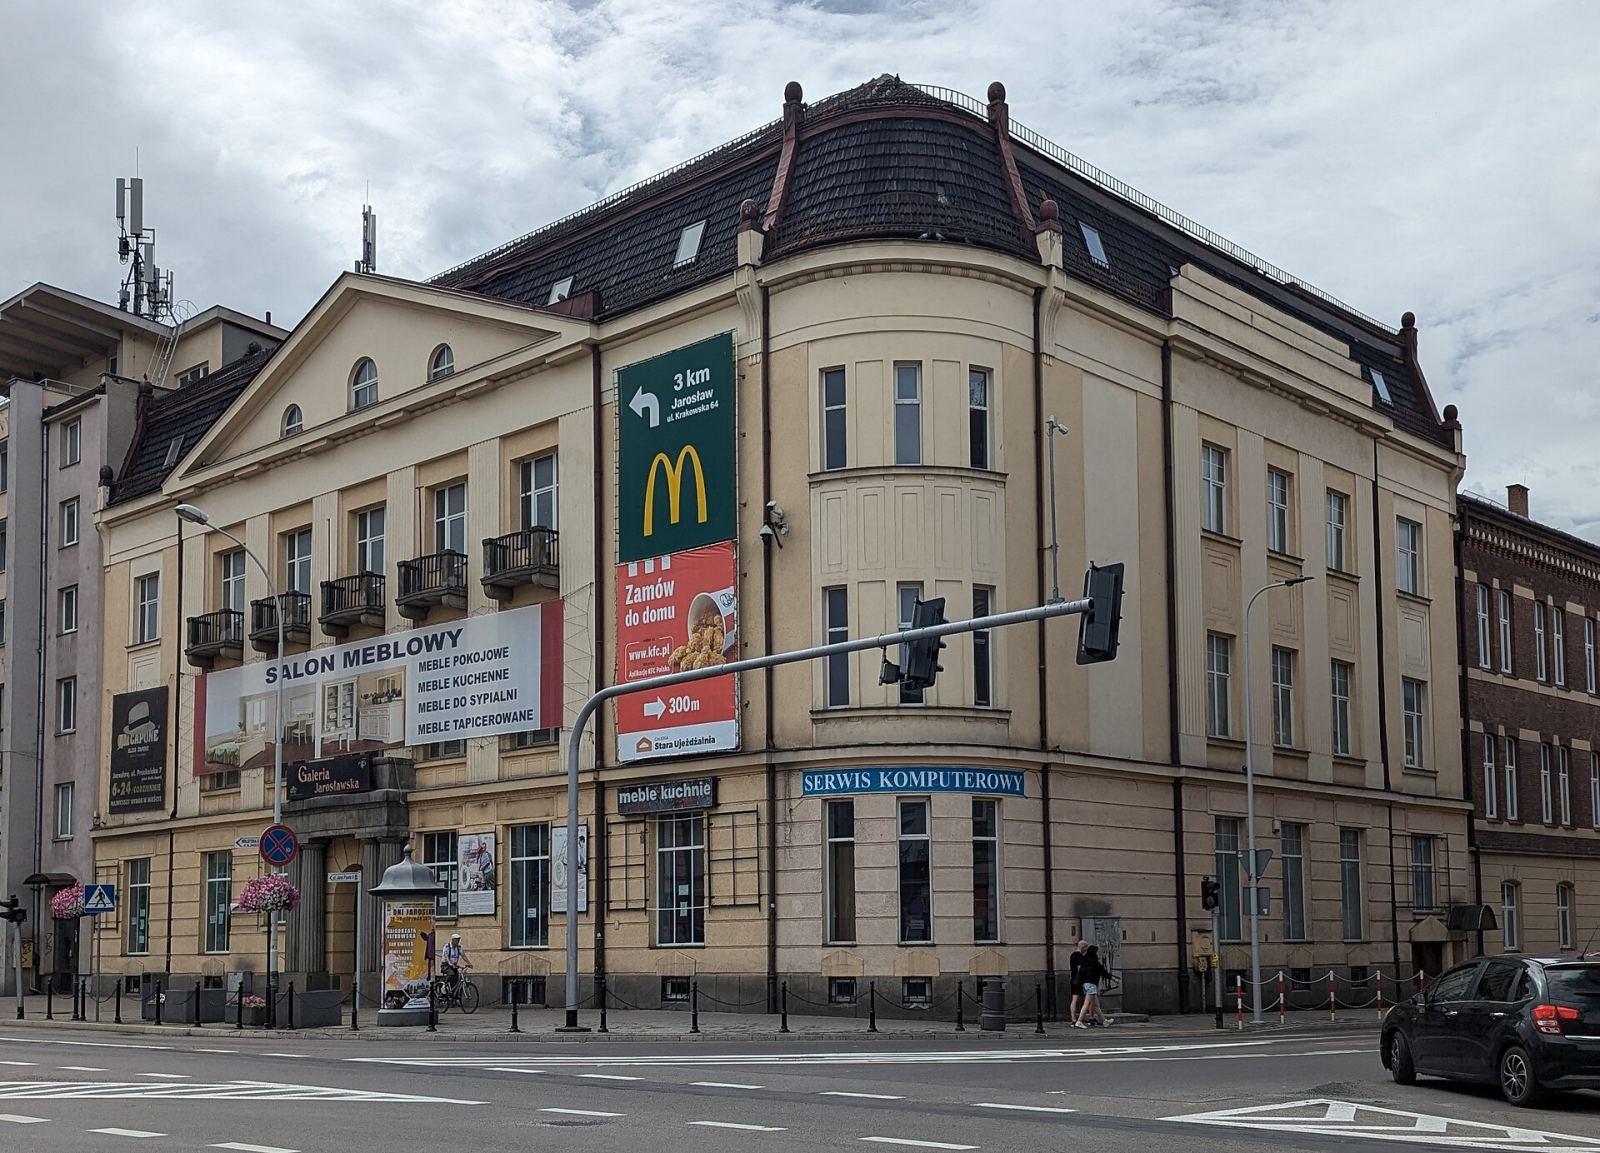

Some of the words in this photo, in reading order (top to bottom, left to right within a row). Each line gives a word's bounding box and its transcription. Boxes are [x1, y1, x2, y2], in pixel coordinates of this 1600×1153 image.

[674, 373, 684, 391] 3
[686, 367, 710, 388] km
[671, 388, 714, 410] Jarosław
[666, 413, 675, 423] ul.
[675, 403, 710, 420] Krakowska
[710, 399, 719, 409] 64
[625, 577, 675, 605] Zamów
[625, 608, 640, 628] do
[642, 605, 675, 624] domu
[265, 653, 335, 684] SALON
[342, 627, 464, 669] MEBLOWY
[418, 656, 451, 673] MEBLE
[452, 646, 510, 667] POKOJOWE
[628, 643, 670, 661] www.kfc.pl
[417, 677, 450, 693] MEBLE
[452, 667, 510, 688] KUCHENNE
[417, 698, 451, 714] MEBLE
[453, 696, 467, 709] DO
[469, 688, 518, 706] SYPIALNI
[668, 695, 700, 714] 300m
[417, 720, 450, 735] MEBLE
[452, 708, 534, 731] TAPICEROWANE
[654, 742, 673, 750] Stara
[298, 765, 330, 783] Galeria
[314, 778, 360, 793] Jarosławska
[804, 772, 871, 792] SERWIS
[879, 770, 1023, 791] KOMPUTEROWY
[619, 787, 657, 804] meble
[661, 781, 711, 800] kuchnie
